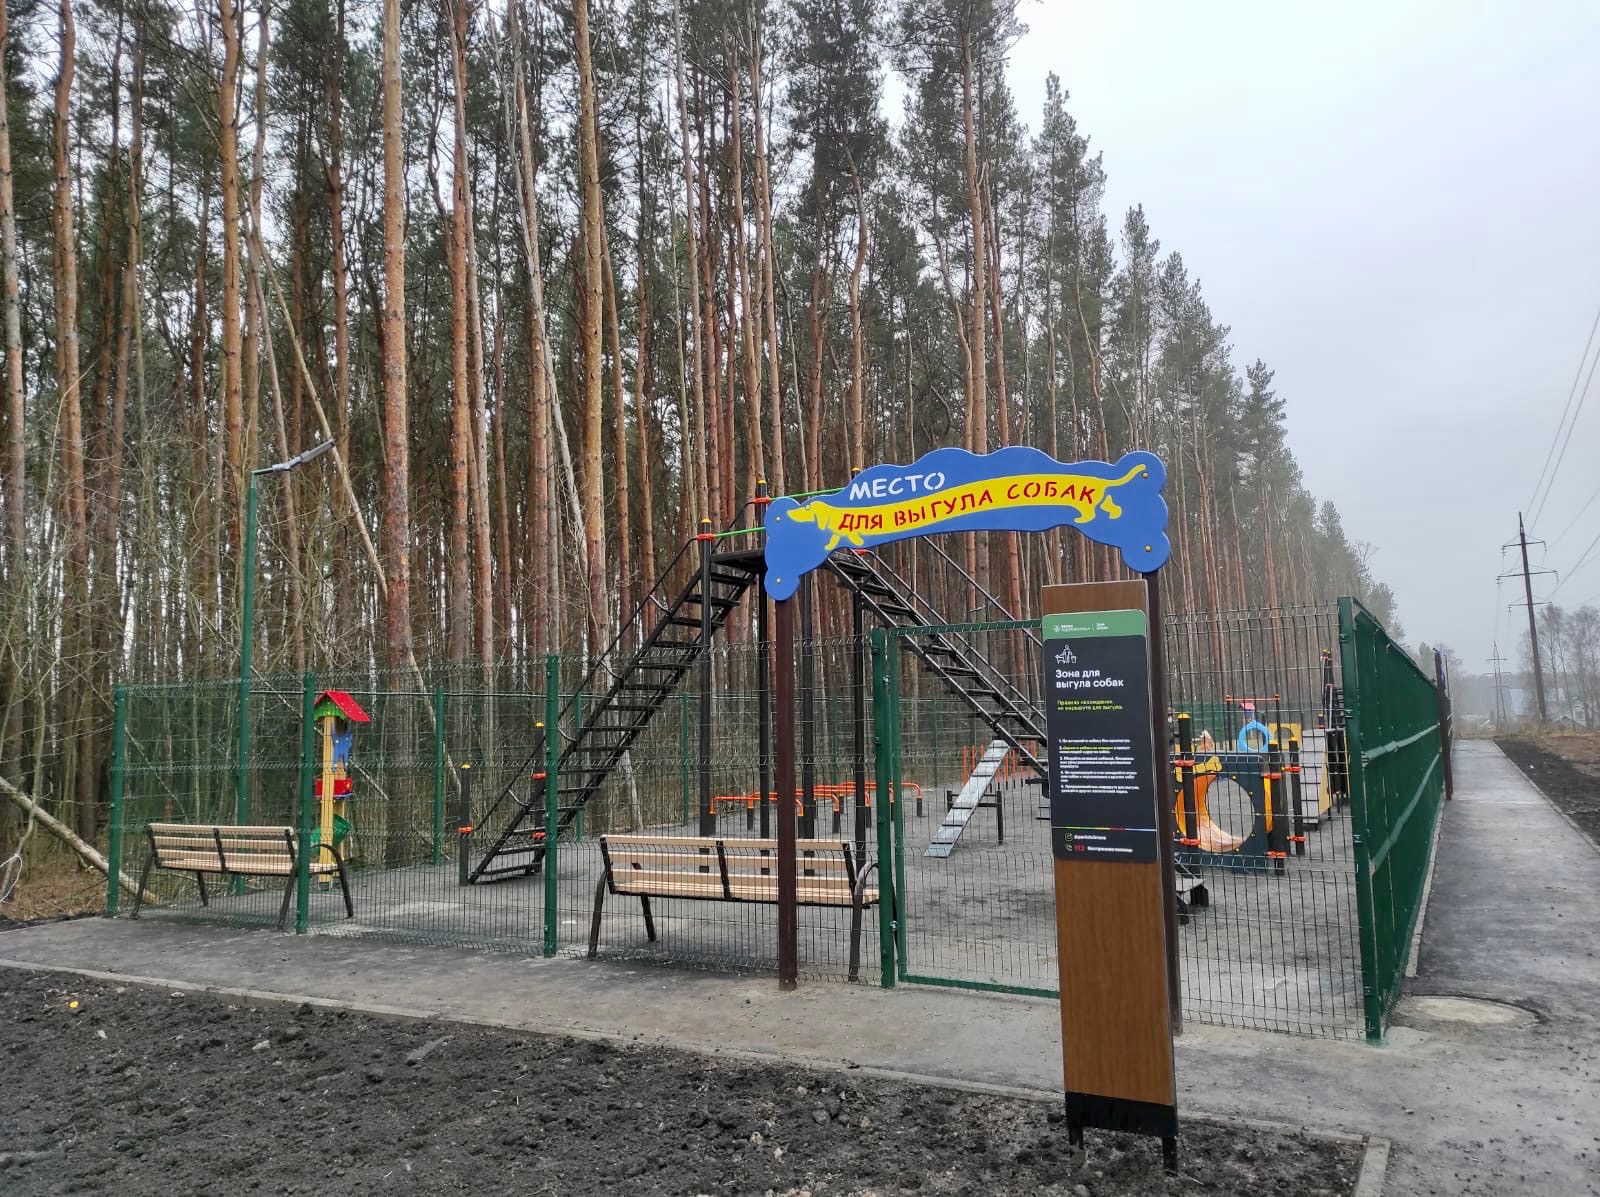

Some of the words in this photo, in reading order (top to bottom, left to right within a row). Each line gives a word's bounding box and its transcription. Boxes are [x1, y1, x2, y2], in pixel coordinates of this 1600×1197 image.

[849, 471, 946, 501] МЕСТО
[838, 512, 883, 532] ДЛЯ
[894, 493, 994, 526] ВЫГУЛА
[1006, 481, 1097, 505] СОБАК
[1055, 669, 1080, 678] Зона
[1082, 670, 1101, 678] для
[1056, 680, 1091, 689] выгула
[1093, 678, 1124, 687] собак
